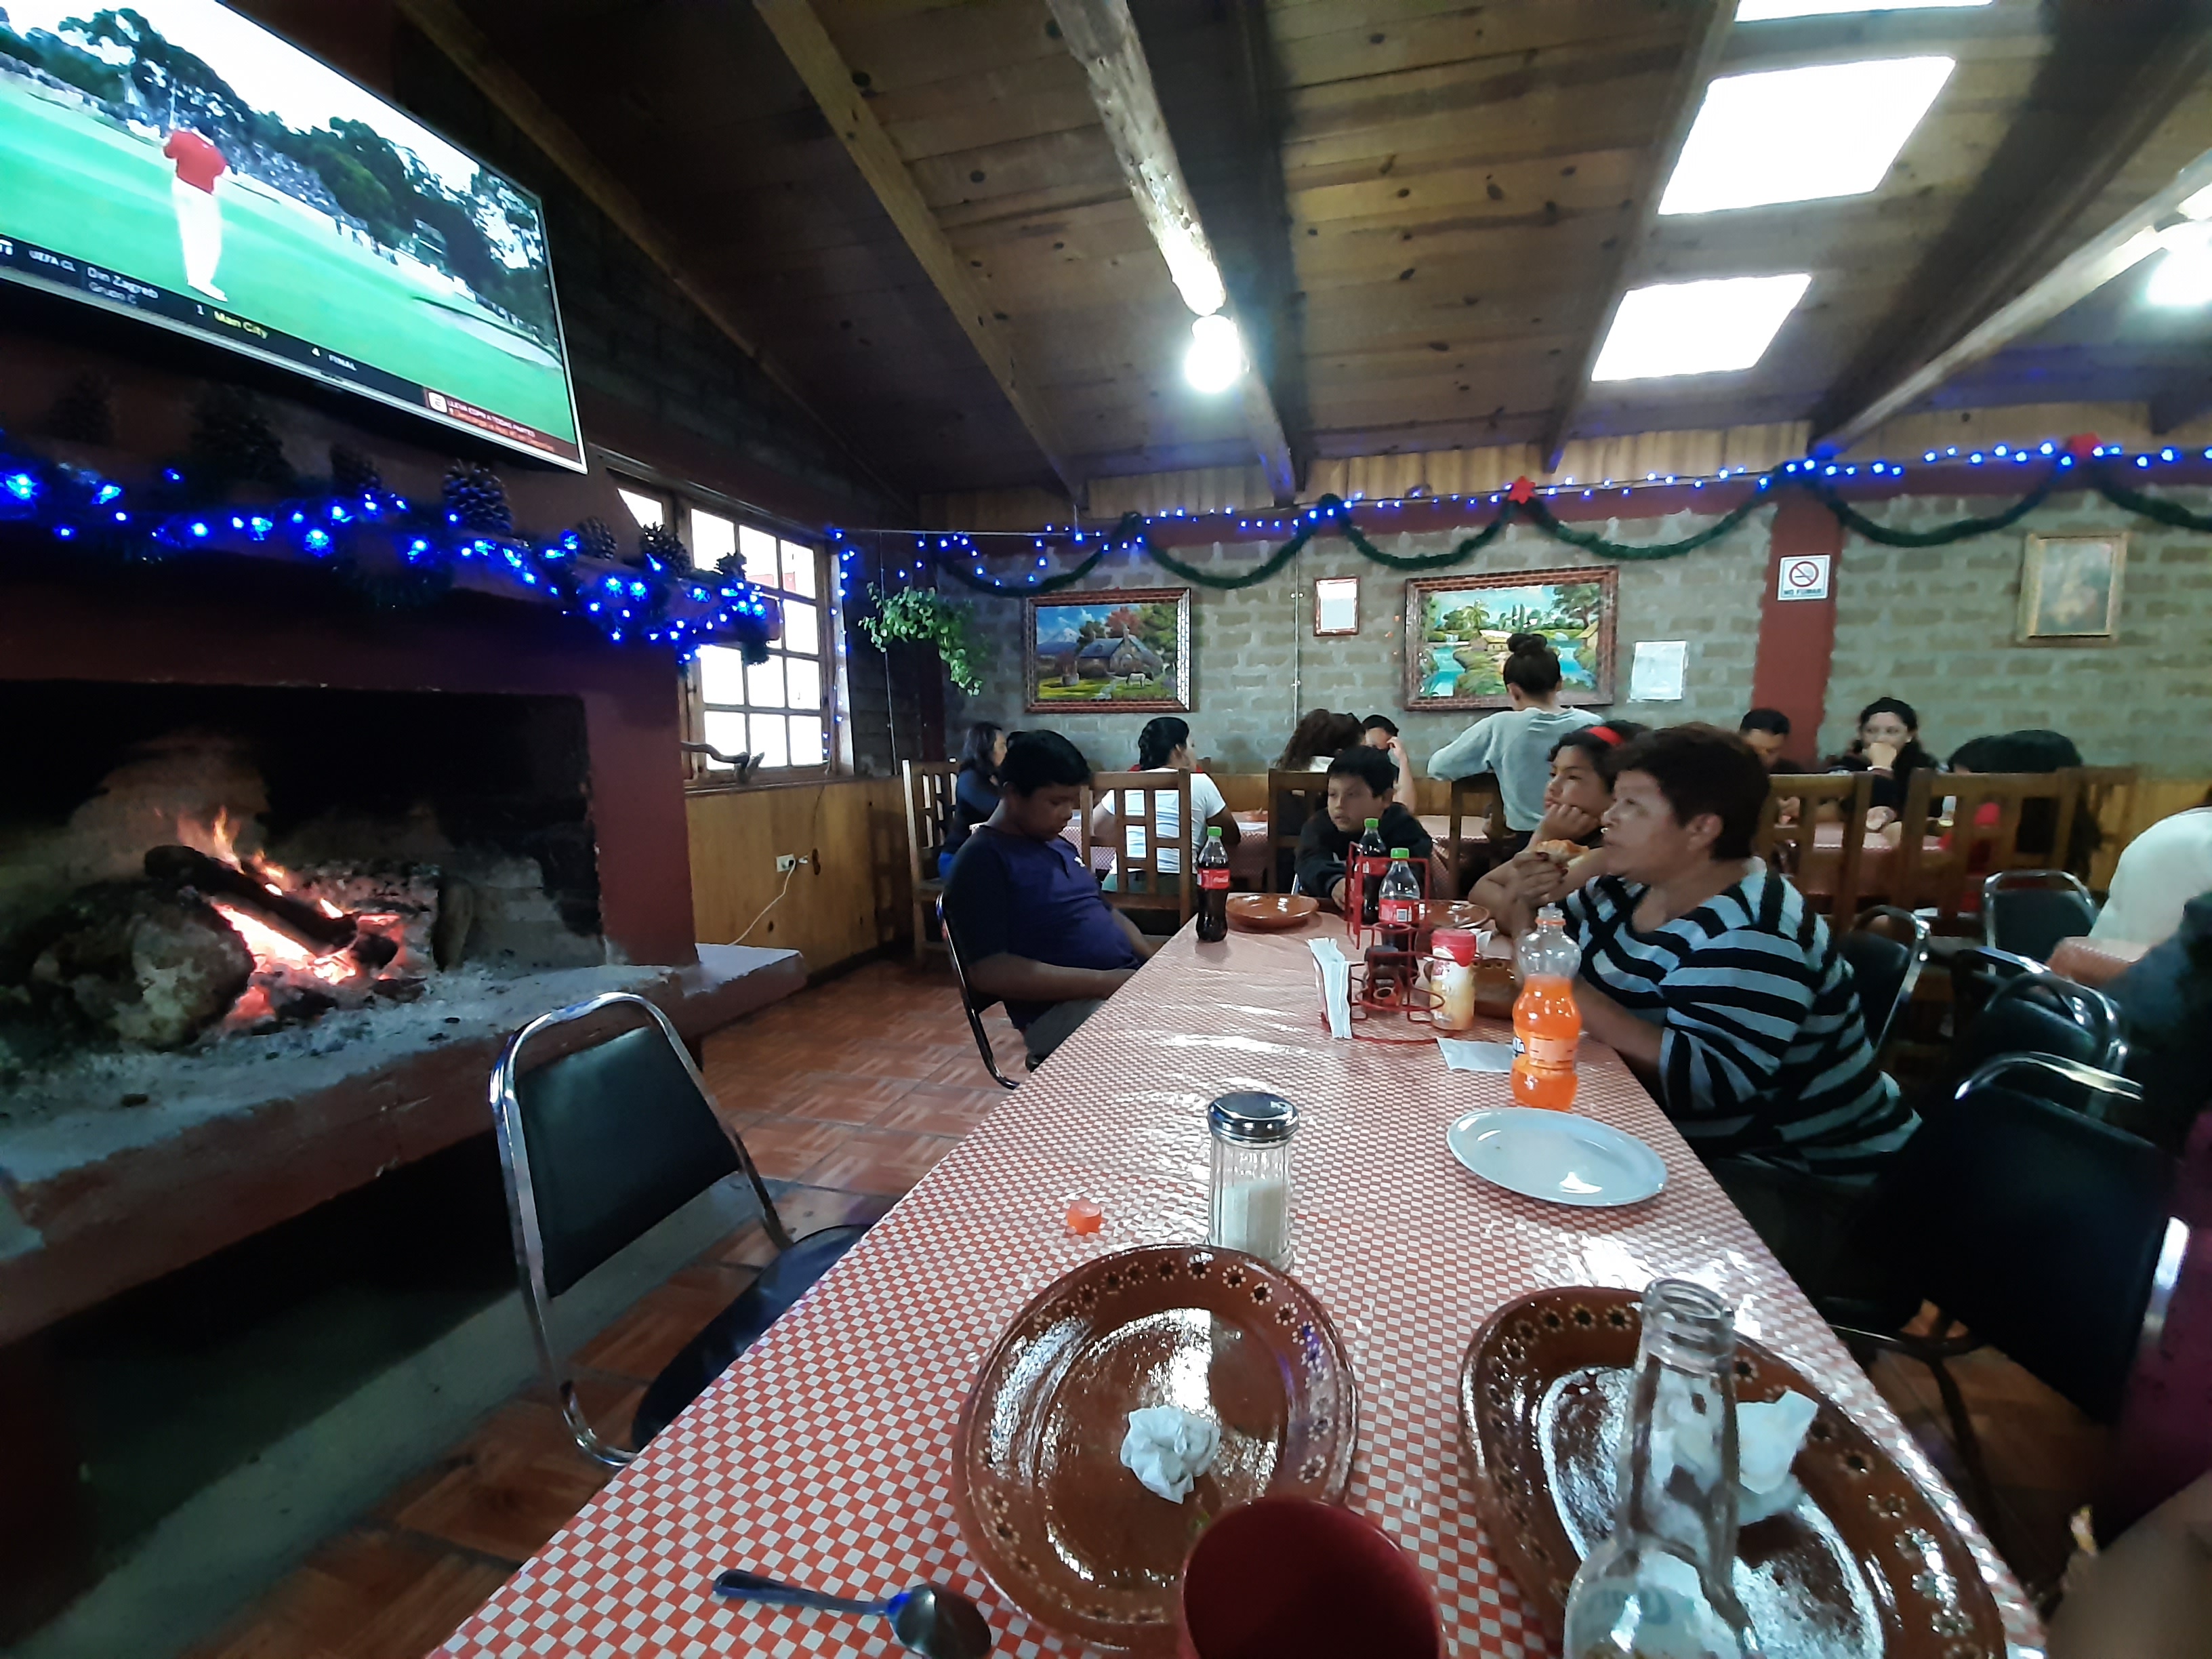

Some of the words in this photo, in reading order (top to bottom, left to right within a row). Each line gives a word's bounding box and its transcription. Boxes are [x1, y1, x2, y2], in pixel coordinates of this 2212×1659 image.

[112, 275, 159, 299] Zagreb
[196, 304, 204, 316] 1
[213, 310, 241, 328] Man
[243, 321, 268, 340] City
